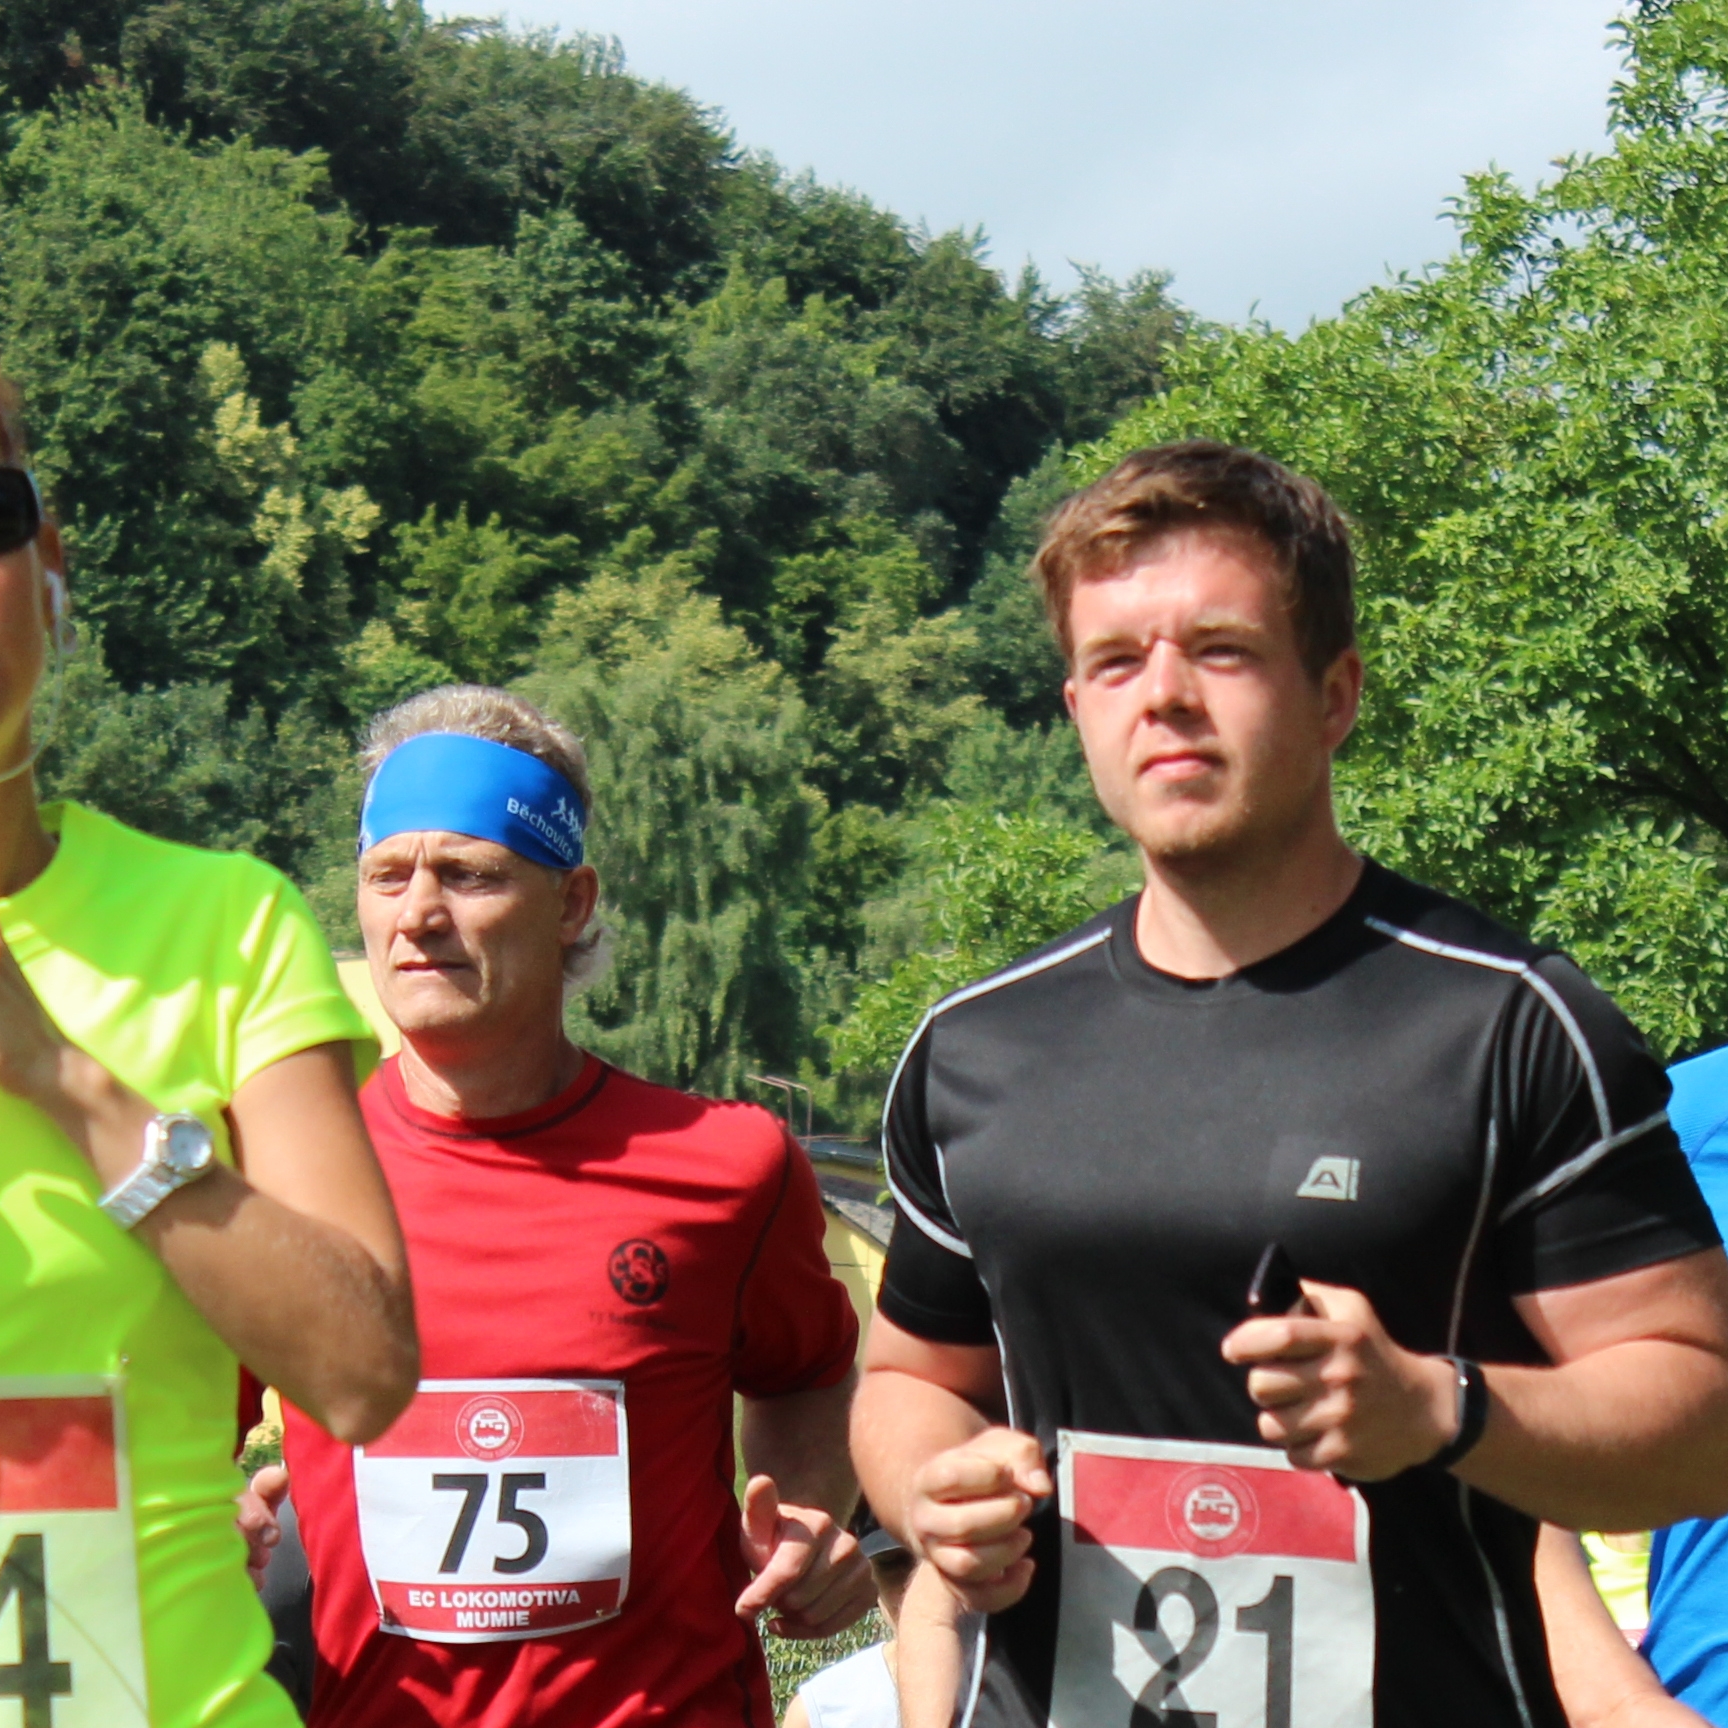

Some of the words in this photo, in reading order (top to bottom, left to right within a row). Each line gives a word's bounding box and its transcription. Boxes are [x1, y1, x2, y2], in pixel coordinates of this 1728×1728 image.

[432, 1472, 549, 1575] 75
[408, 1589, 435, 1608] EC
[440, 1589, 581, 1609] LOKOMOTIVA
[456, 1610, 530, 1629] MUMIE
